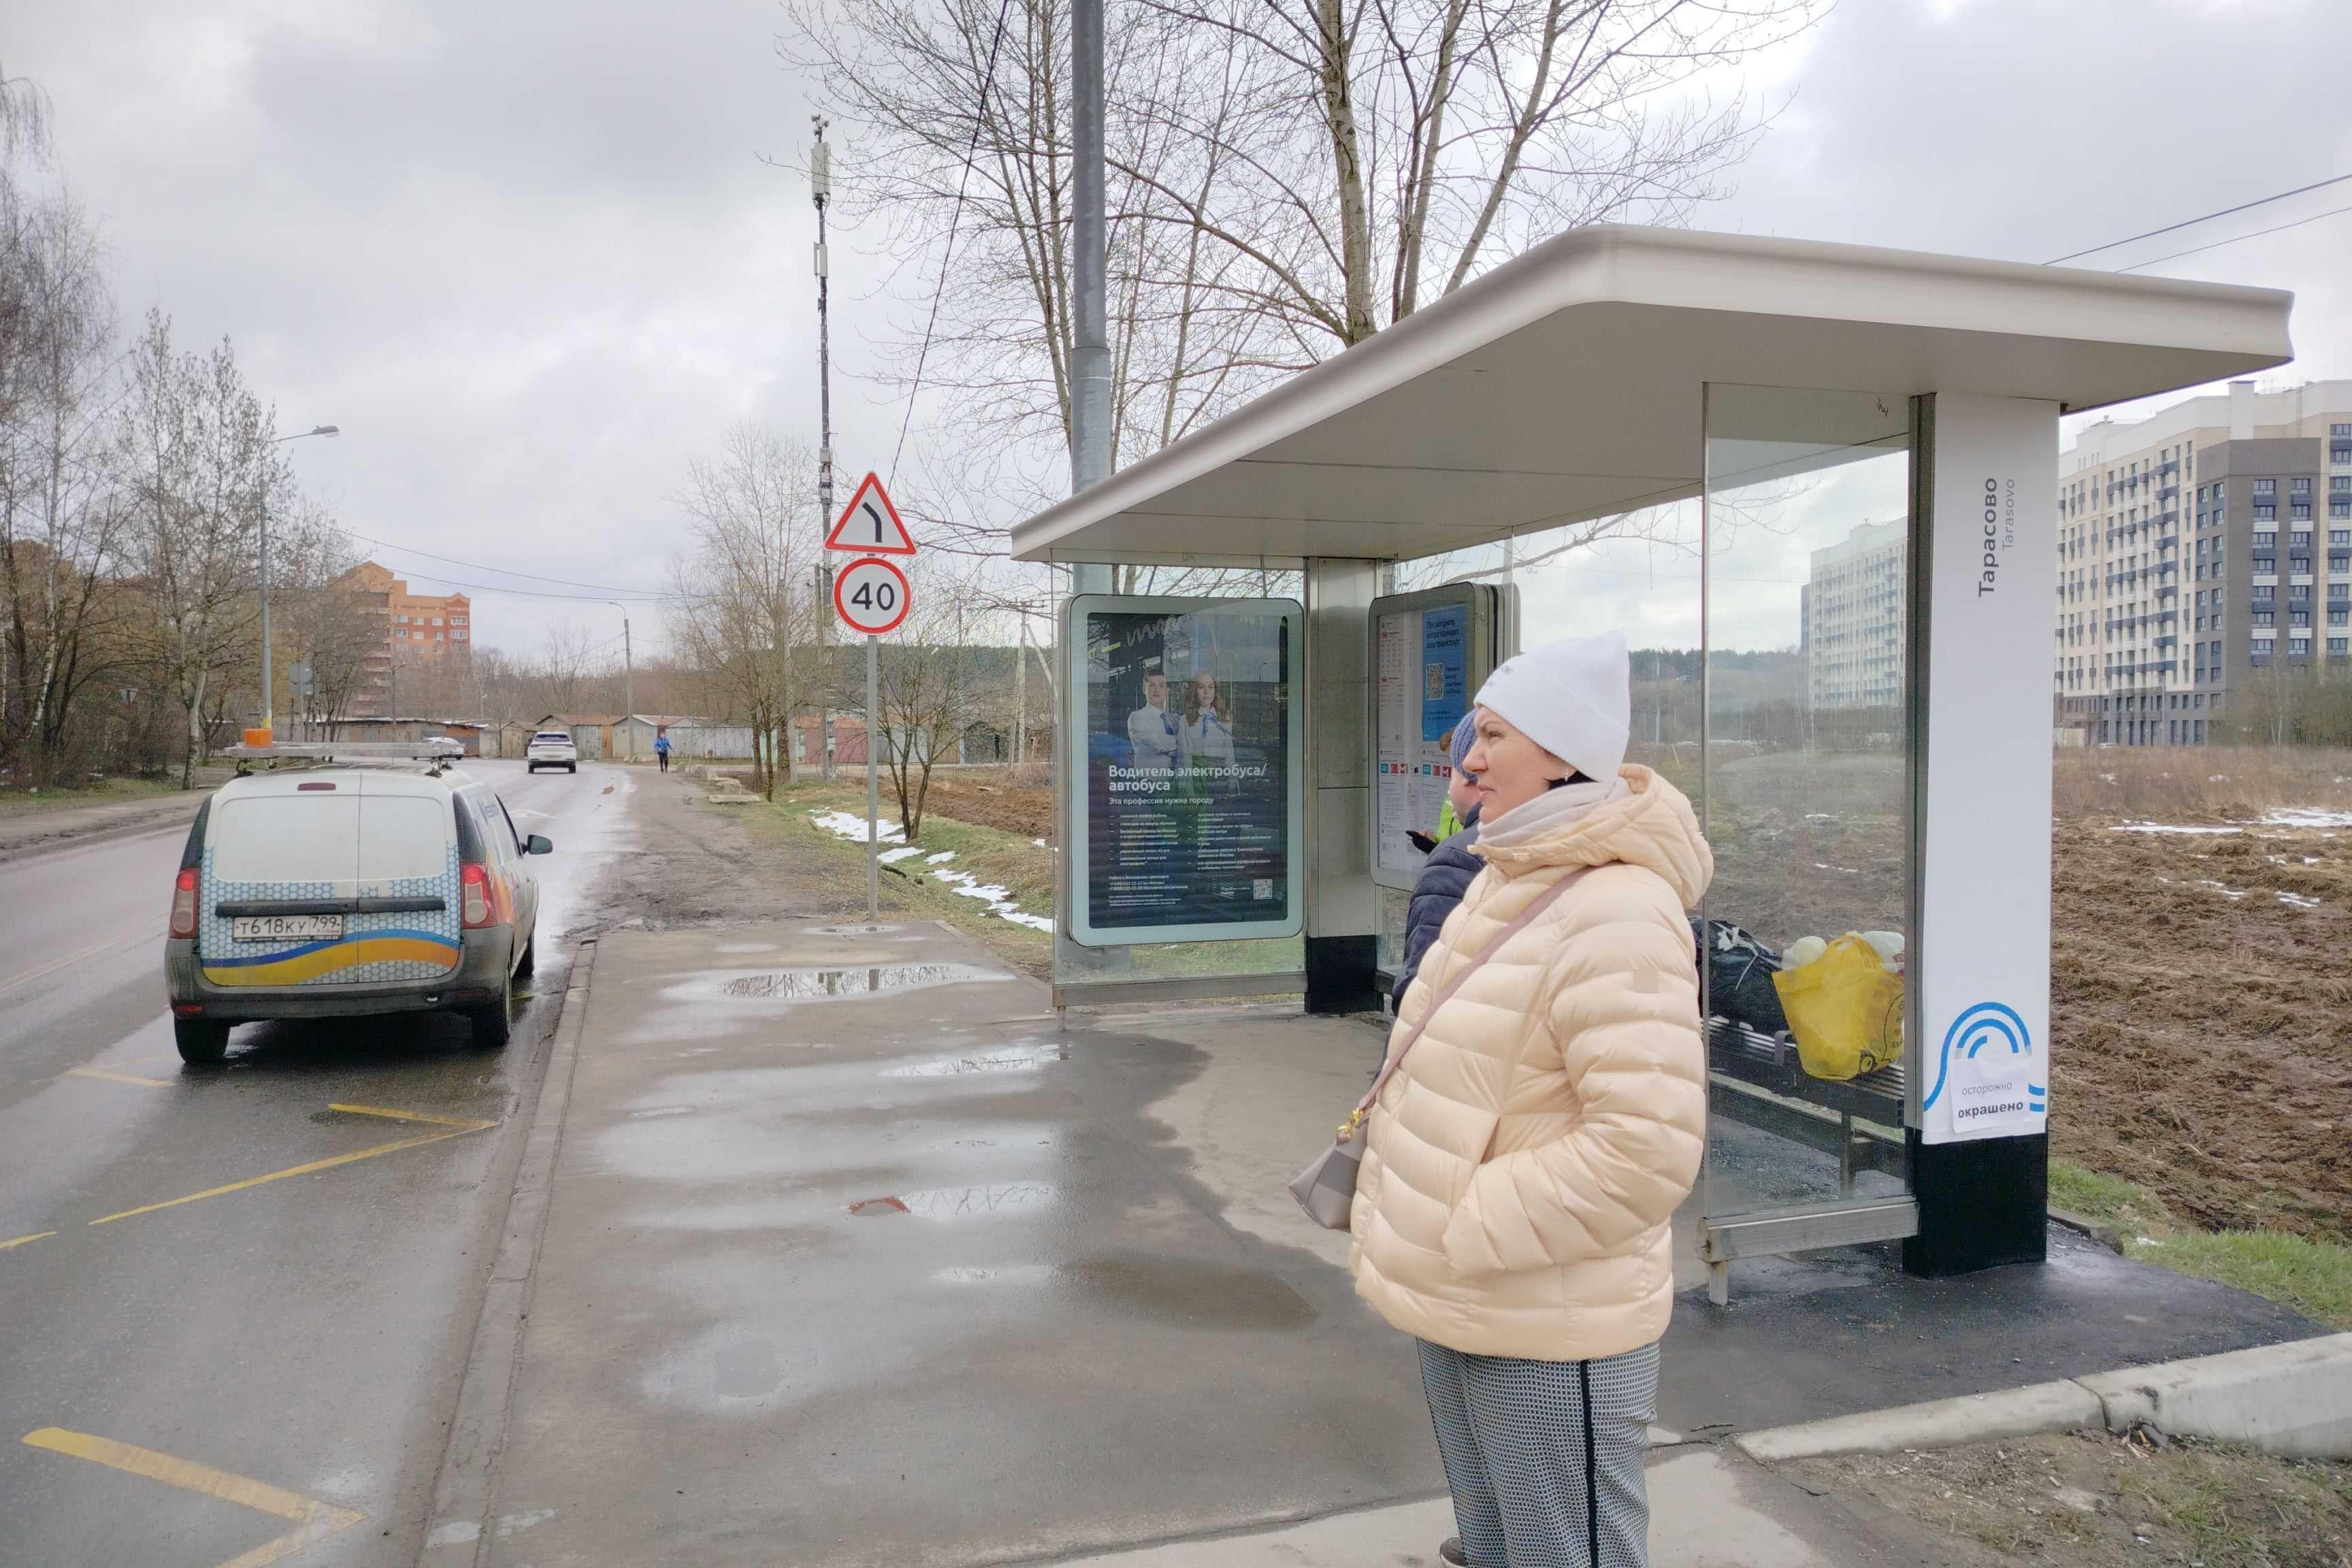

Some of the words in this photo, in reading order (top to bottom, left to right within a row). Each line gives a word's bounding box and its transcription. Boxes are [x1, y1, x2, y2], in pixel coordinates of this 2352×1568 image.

[2002, 478, 2014, 551] Tarasovo
[1978, 478, 1998, 598] Тарасово
[851, 582, 895, 611] 40
[1109, 765, 1174, 779] Водитель
[1177, 763, 1267, 779] электробуса/
[1109, 779, 1171, 794] автобуса
[1124, 798, 1163, 806] профессия
[240, 919, 306, 934] Т618КУ
[312, 916, 338, 929] 799
[1961, 1082, 2012, 1096] осторожно
[1958, 1101, 2024, 1120] окрашено
